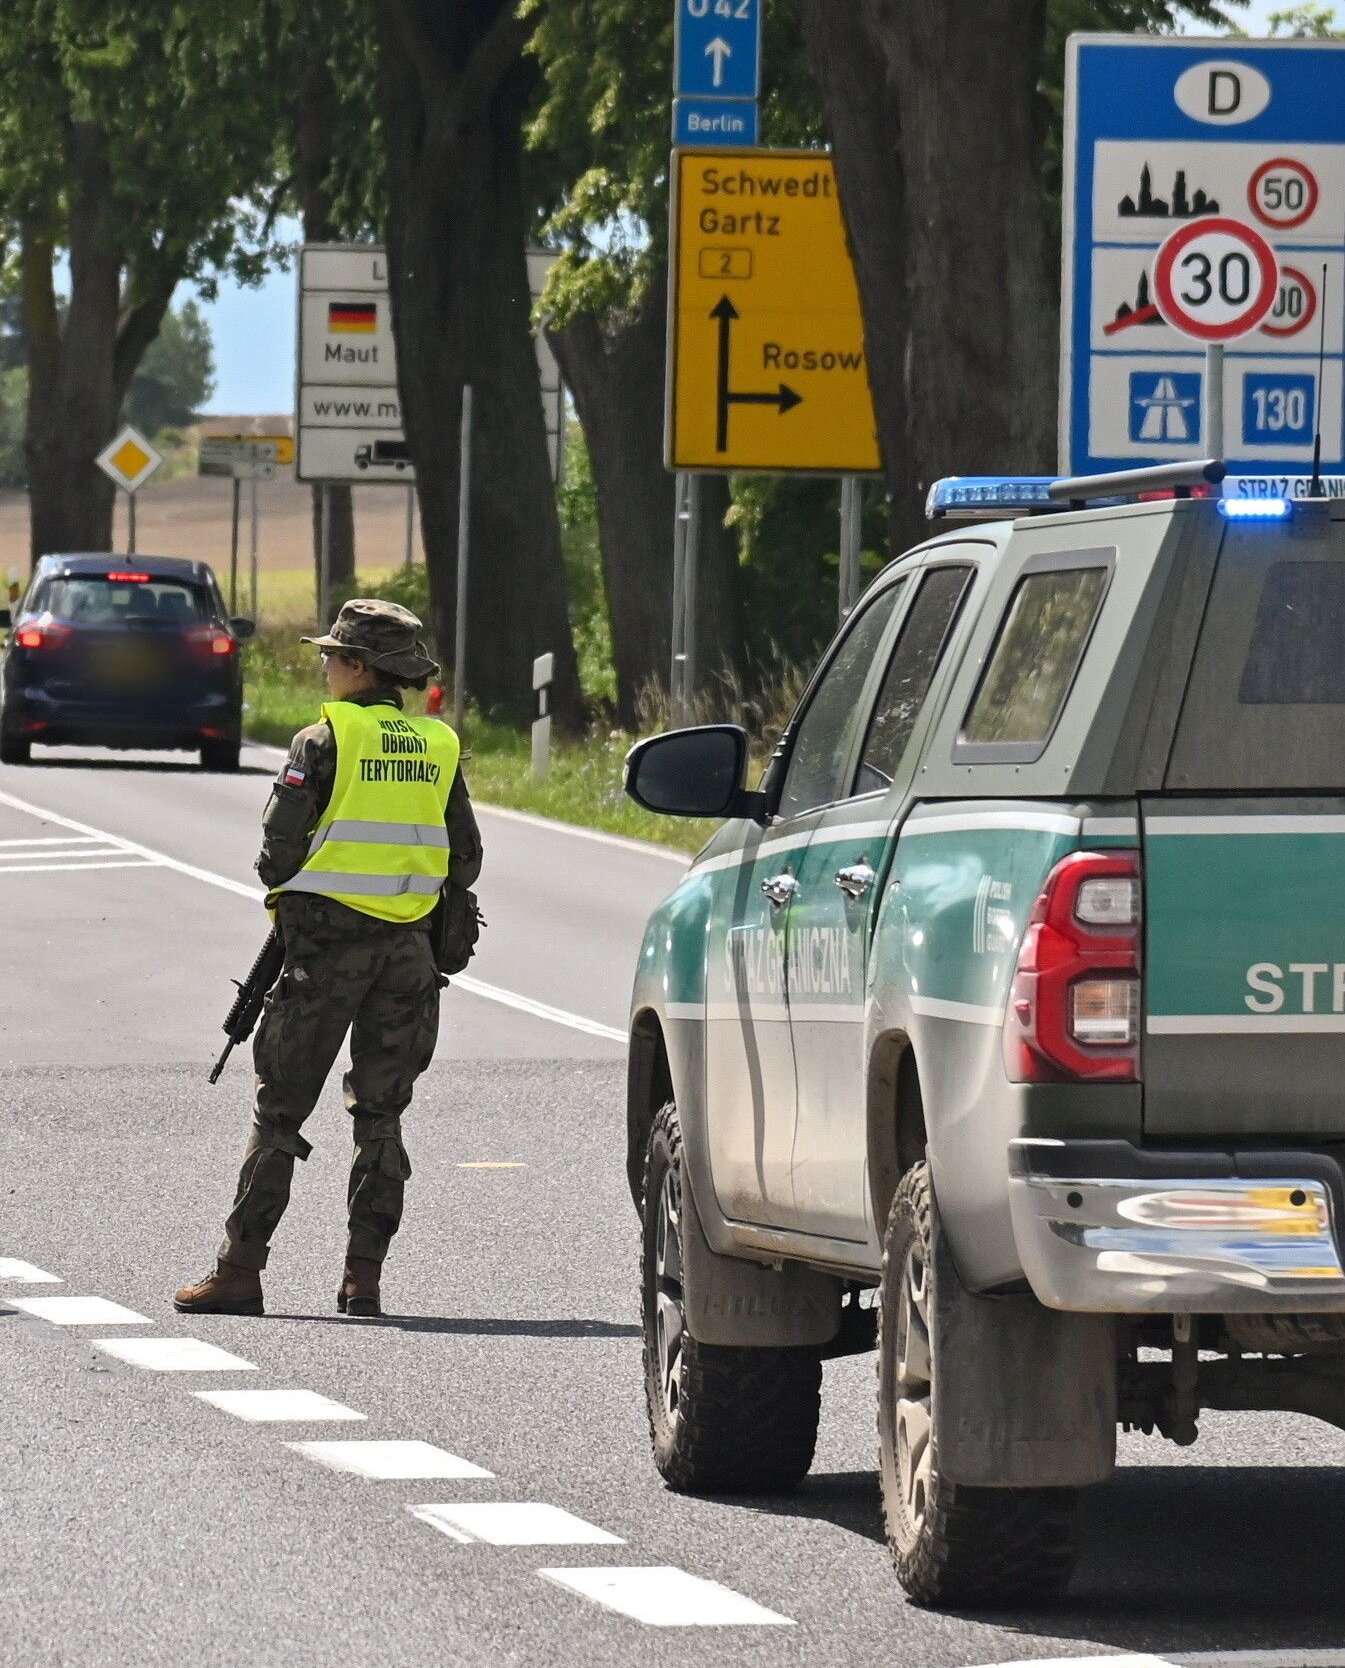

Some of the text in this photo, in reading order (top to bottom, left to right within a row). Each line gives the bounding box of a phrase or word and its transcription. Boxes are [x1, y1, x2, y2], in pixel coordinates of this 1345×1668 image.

[1208, 71, 1241, 116] D
[688, 114, 744, 133] Berlin
[701, 169, 831, 197] Schwedt
[1263, 178, 1304, 210] 50
[699, 209, 781, 236] Gartz
[720, 254, 732, 274] 2
[1181, 252, 1251, 307] 30
[324, 344, 379, 363] Maut
[763, 343, 864, 371] Rosow
[1252, 389, 1305, 432] 130
